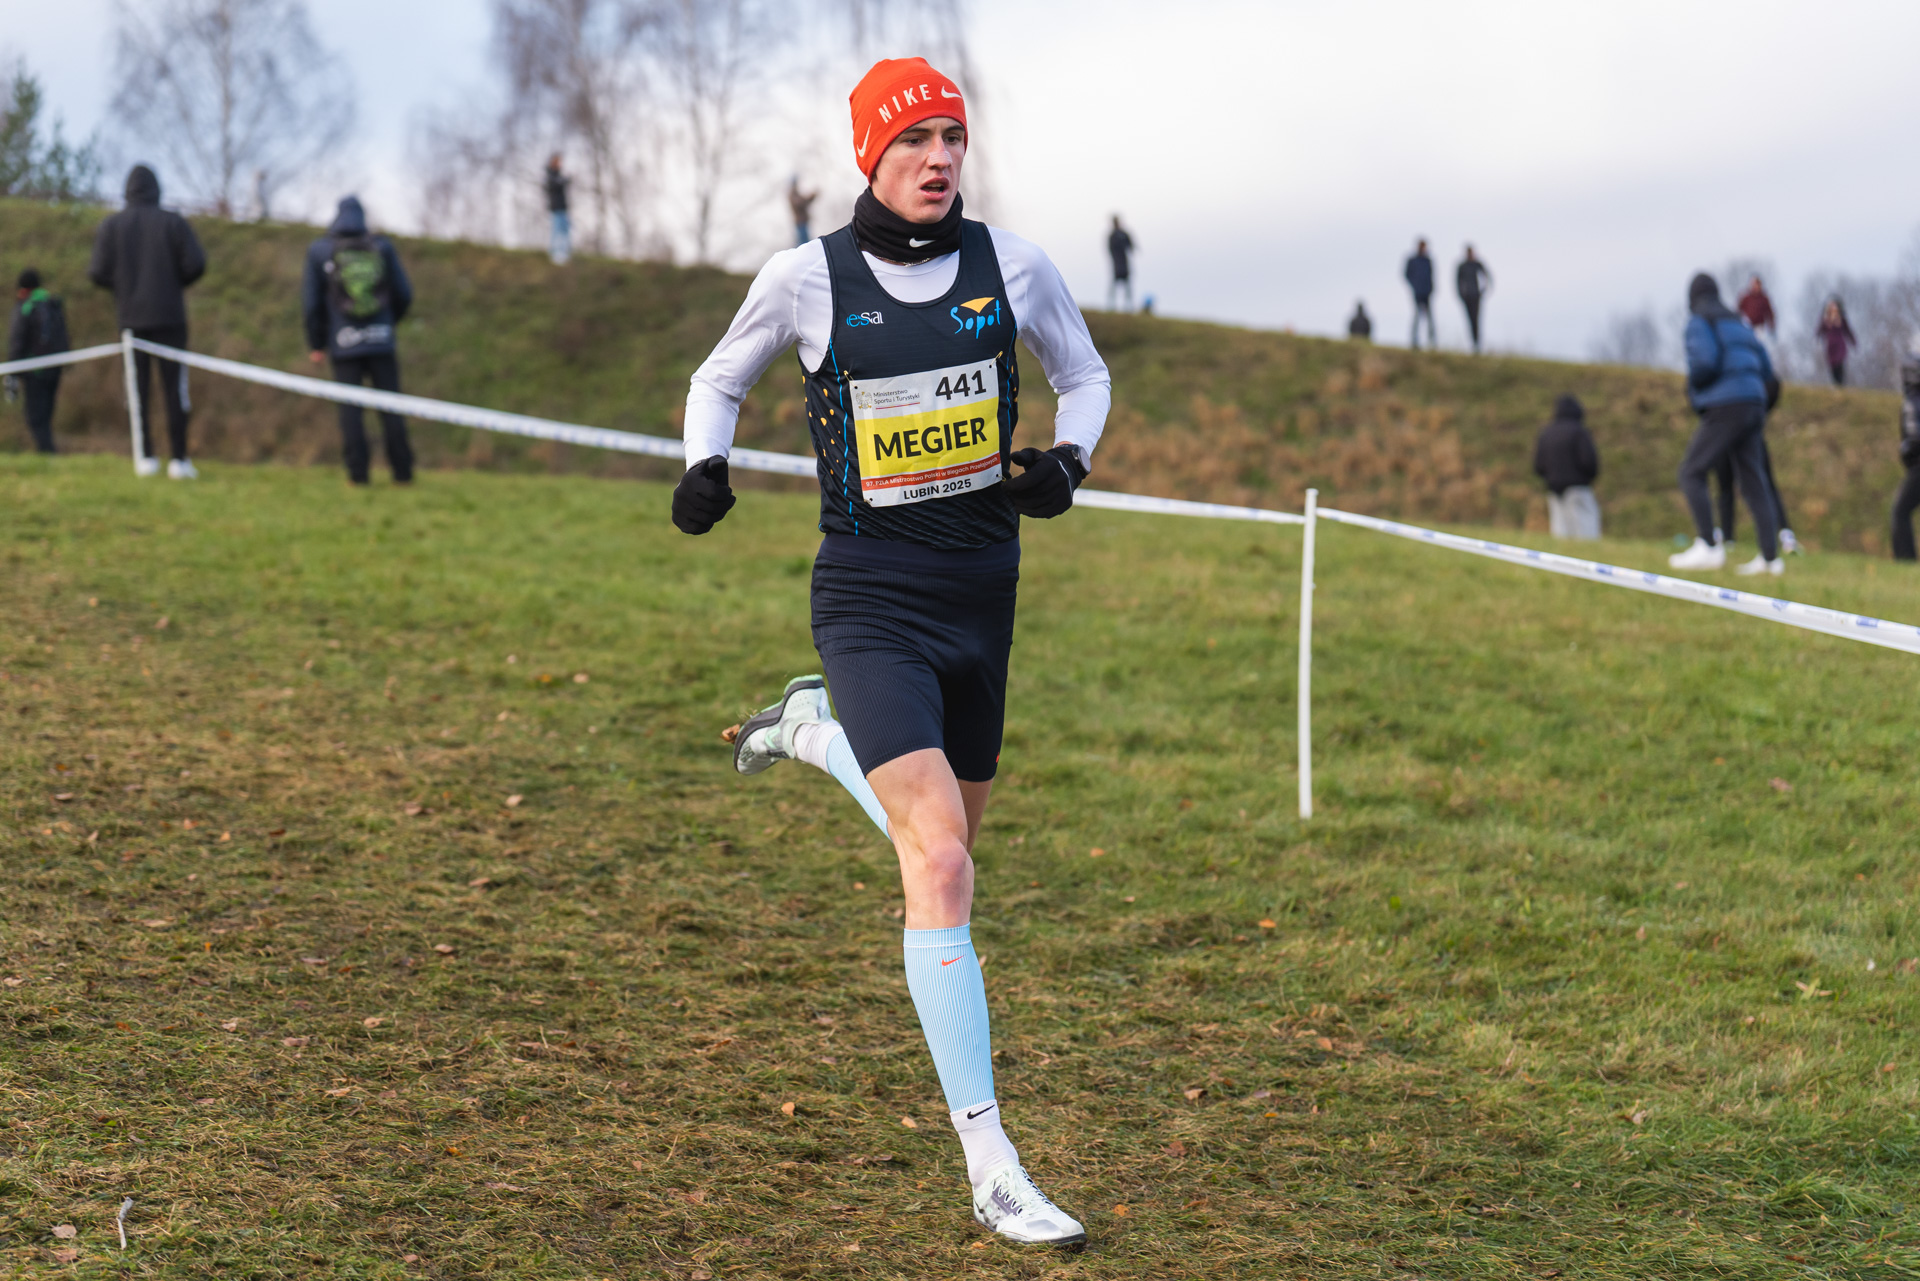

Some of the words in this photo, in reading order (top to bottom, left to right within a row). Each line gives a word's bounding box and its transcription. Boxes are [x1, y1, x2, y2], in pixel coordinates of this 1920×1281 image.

[878, 84, 932, 124] NIKE
[950, 299, 1001, 339] Sopot
[873, 389, 908, 398] Ministerstwo
[896, 393, 920, 402] Turystyki
[935, 370, 987, 400] 441
[873, 417, 987, 461] MEGIER
[890, 476, 924, 484] Mistrzostwo
[924, 471, 940, 480] Polski
[903, 485, 940, 500] LUBIN
[942, 479, 972, 493] 2025
